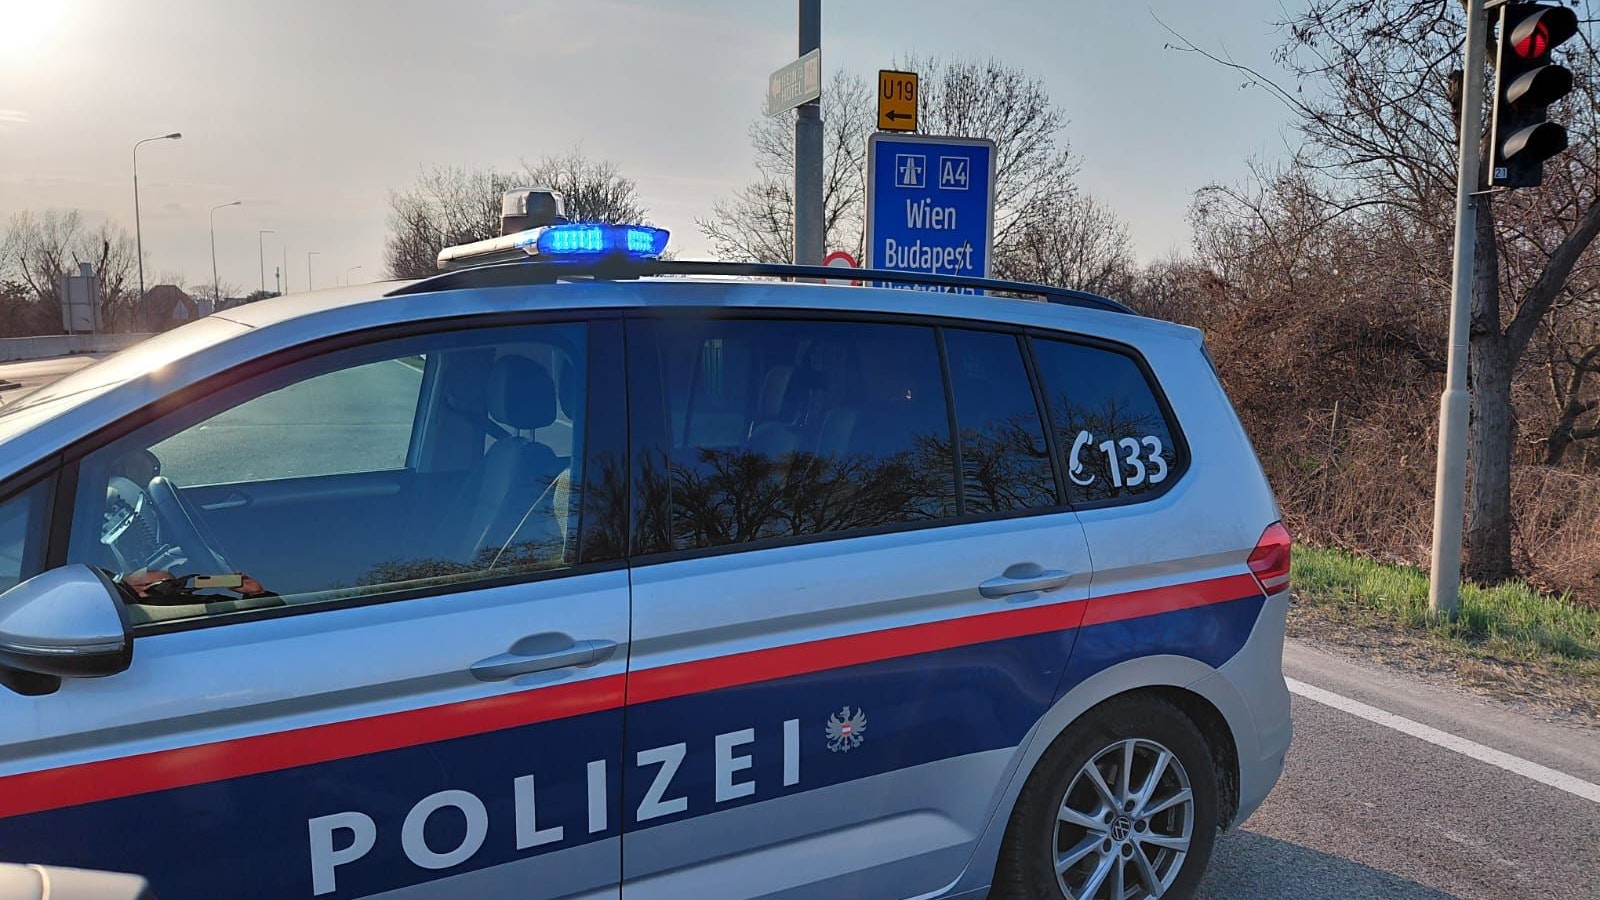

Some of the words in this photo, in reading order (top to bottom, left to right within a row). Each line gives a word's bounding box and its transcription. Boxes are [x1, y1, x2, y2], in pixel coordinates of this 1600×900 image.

[883, 79, 914, 101] U19
[942, 161, 967, 186] A4
[906, 198, 957, 230] Wien
[885, 238, 974, 275] Budapest
[1098, 435, 1168, 488] 133
[308, 718, 800, 896] POLIZEI
